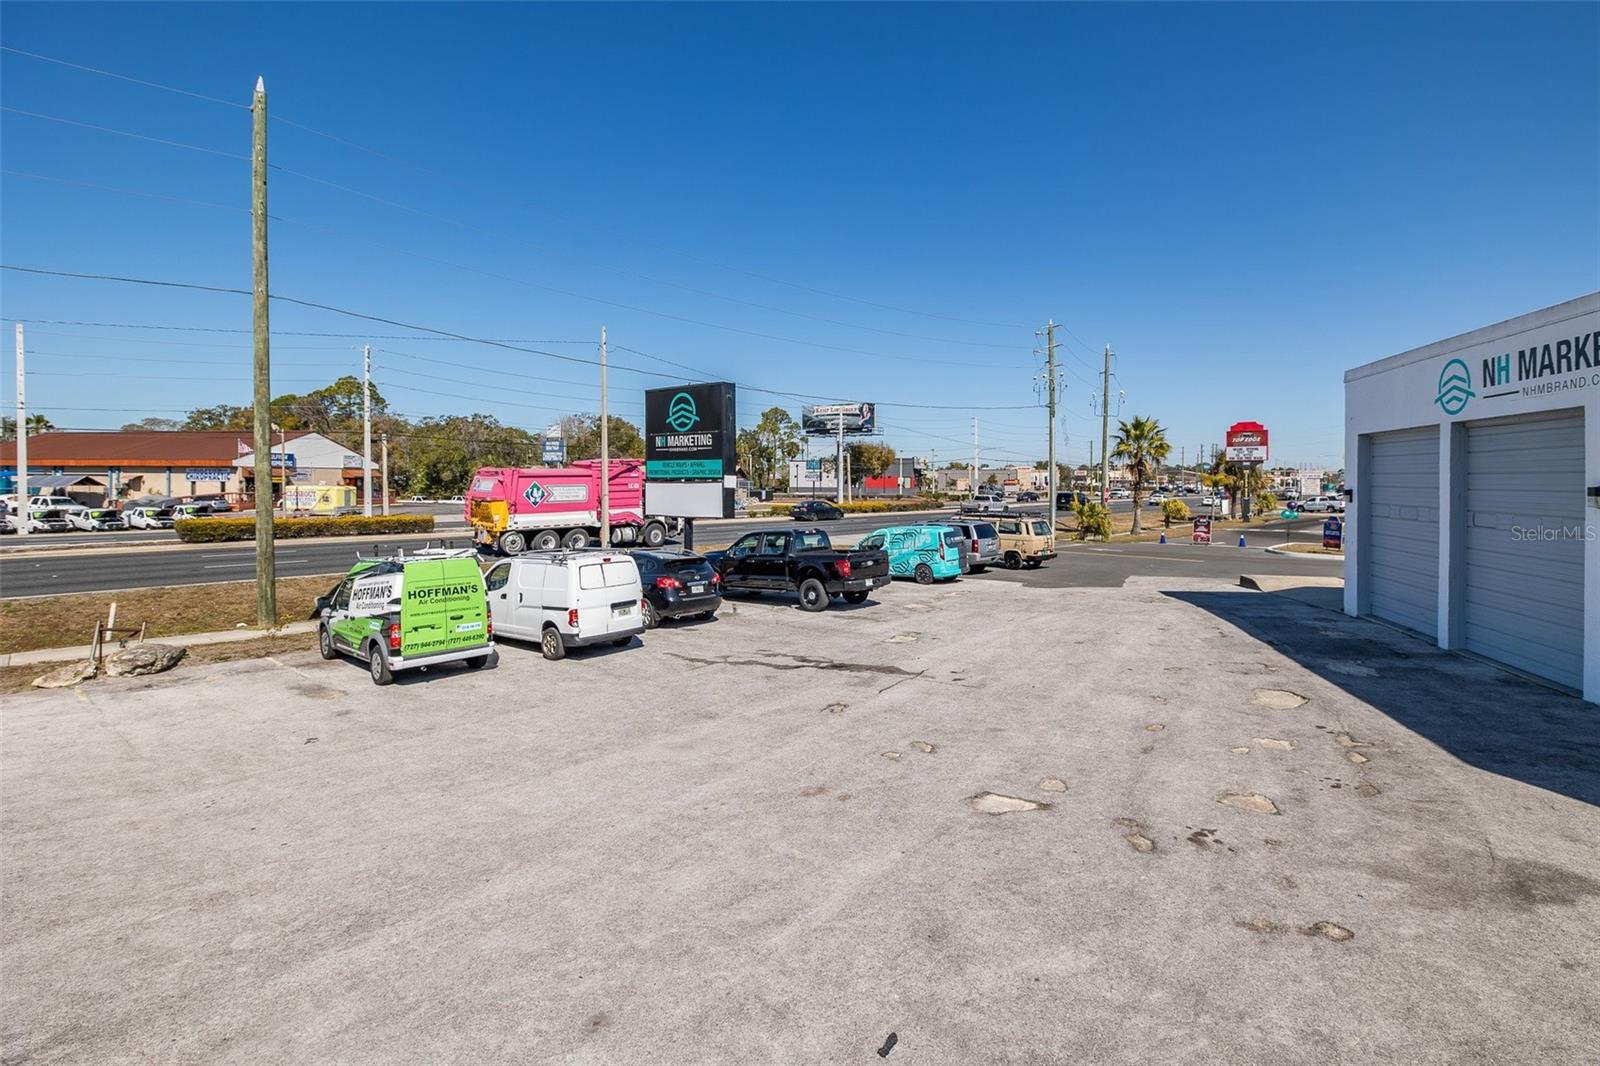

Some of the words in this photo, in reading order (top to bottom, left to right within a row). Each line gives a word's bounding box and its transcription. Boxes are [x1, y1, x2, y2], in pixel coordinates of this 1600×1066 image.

[1483, 353, 1510, 388] NH
[655, 436, 666, 448] NH
[667, 434, 713, 447] MARKETING
[352, 585, 392, 601] HOFFMAN'S
[408, 584, 478, 600] HOFFMAN'S
[430, 595, 470, 605] Conditioning
[404, 643, 419, 651] (727)
[447, 636, 461, 645] (727)
